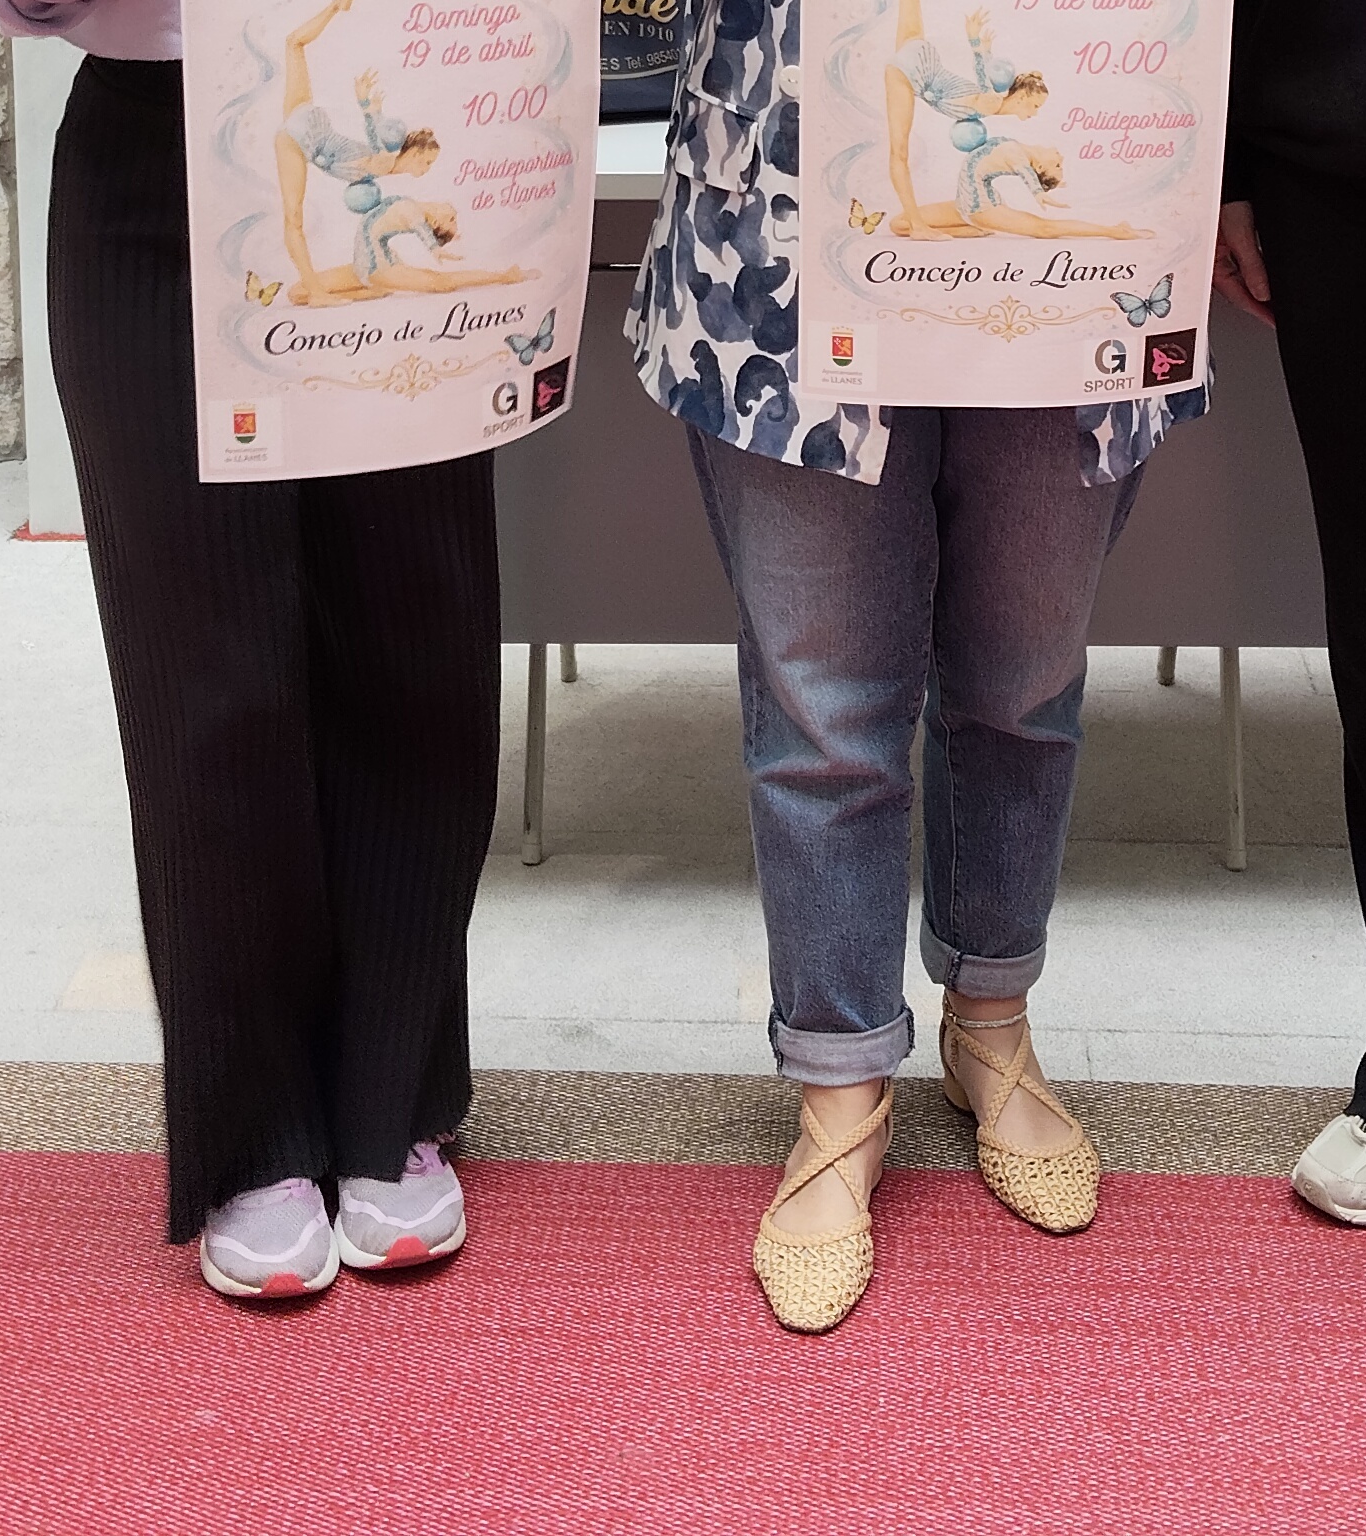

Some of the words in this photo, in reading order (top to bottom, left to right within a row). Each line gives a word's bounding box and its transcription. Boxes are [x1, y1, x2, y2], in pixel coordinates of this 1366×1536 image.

[402, 2, 521, 36] Domingo
[604, 21, 631, 36] EN
[638, 23, 675, 43] 1910
[400, 38, 432, 69] 19
[440, 36, 473, 67] de
[478, 31, 535, 63] abril
[1073, 40, 1168, 75] 10:00
[1060, 106, 1197, 139] Polideportivo
[1078, 139, 1105, 160] de
[1110, 134, 1175, 164] Llanes
[453, 150, 574, 187] Polideportivo
[471, 189, 495, 211] de
[499, 178, 557, 211] Llanes
[864, 250, 983, 292] Concejo
[992, 262, 1024, 283] de
[1029, 250, 1137, 289] Llanes
[263, 319, 384, 358] Concejo
[393, 319, 425, 342] de
[430, 300, 528, 344] Llanes
[830, 376, 863, 386] LLANES
[1083, 376, 1136, 393] SPORT
[482, 414, 526, 439] SPORT
